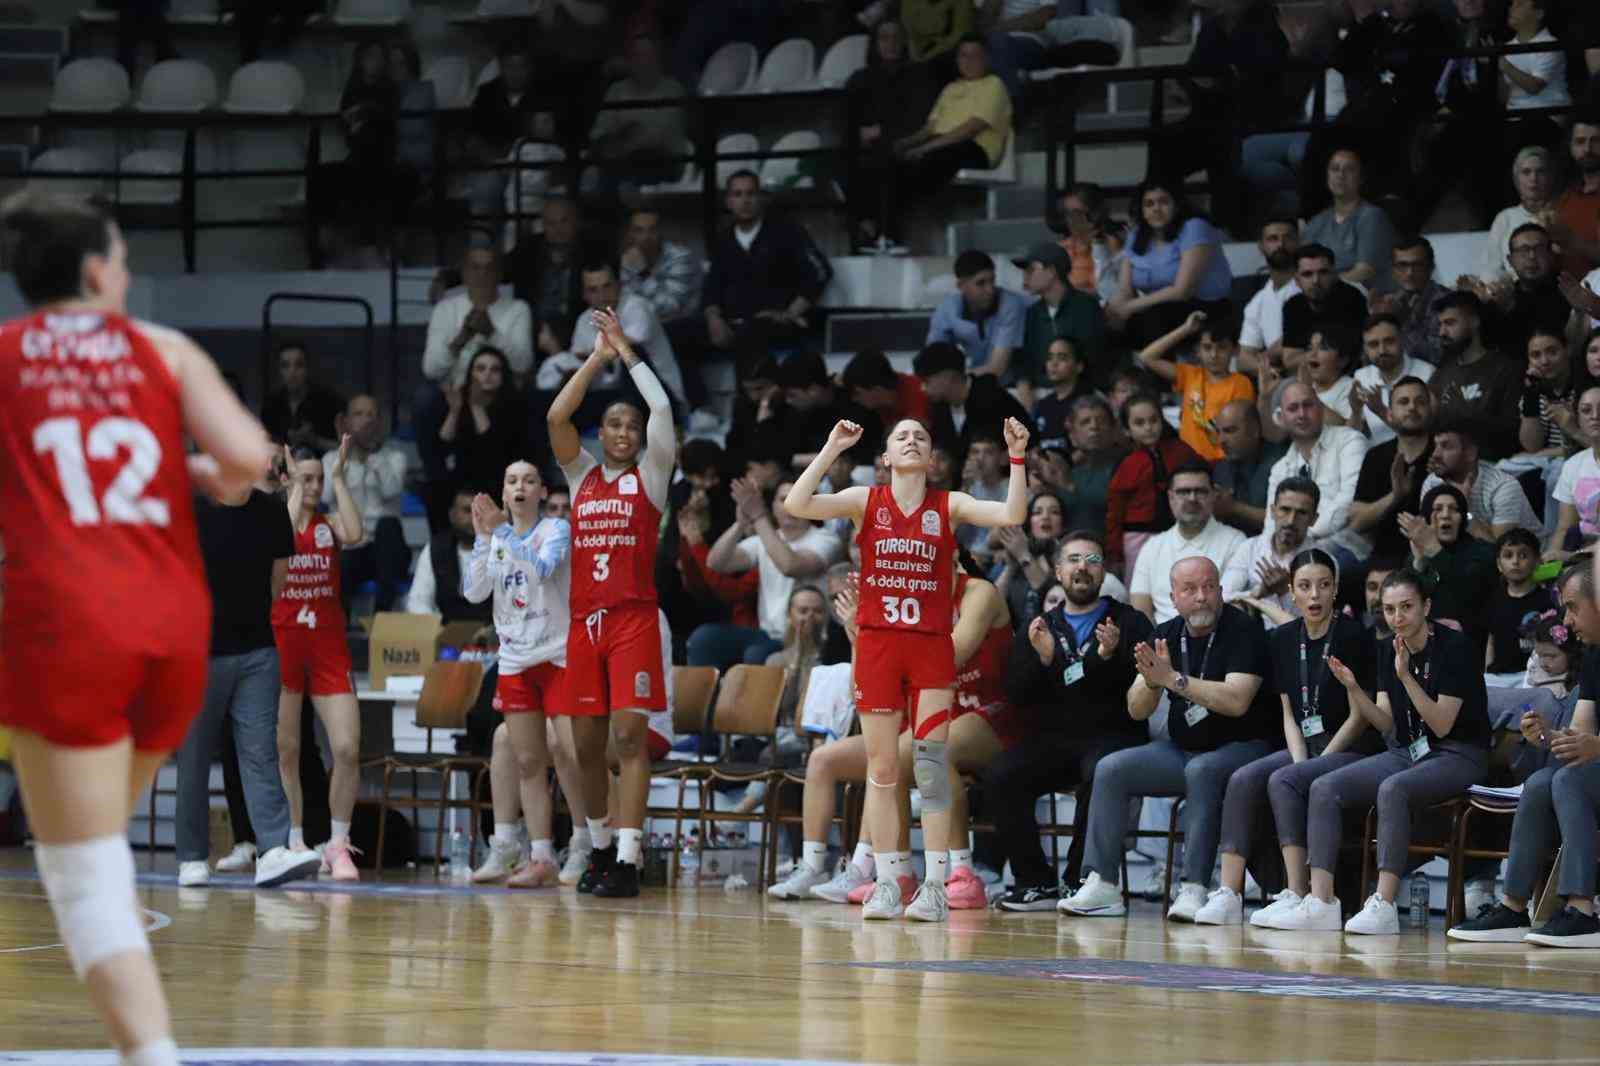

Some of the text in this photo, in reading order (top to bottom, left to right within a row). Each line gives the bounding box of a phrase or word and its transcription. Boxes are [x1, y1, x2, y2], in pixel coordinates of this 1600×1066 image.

[33, 416, 171, 527] 12
[577, 499, 632, 518] TURGUTLU
[875, 538, 937, 560] TURGUTLU
[592, 553, 610, 582] 3
[875, 559, 932, 573] BELEDİYESİ
[908, 579, 937, 592] gross
[296, 604, 318, 629] 4
[881, 595, 921, 625] 30
